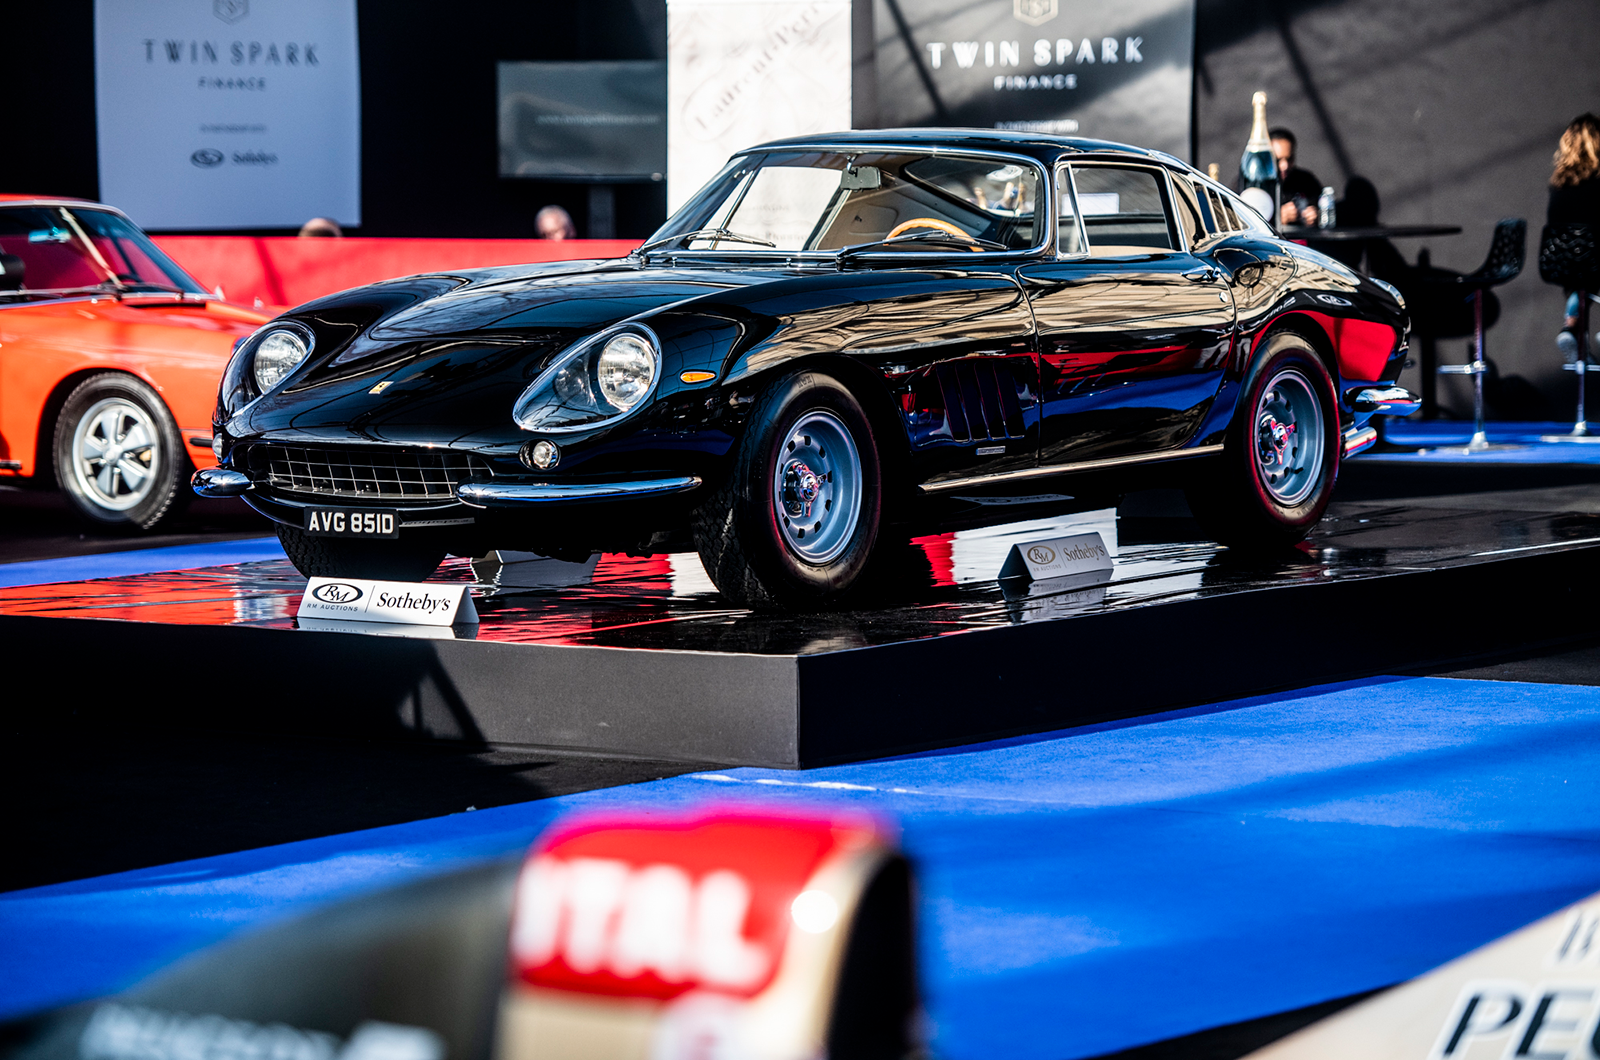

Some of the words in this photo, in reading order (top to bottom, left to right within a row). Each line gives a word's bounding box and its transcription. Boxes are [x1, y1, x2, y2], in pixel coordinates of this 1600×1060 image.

[142, 38, 218, 64] TWIN
[229, 40, 320, 66] SPARK
[926, 40, 1020, 69] TWIN
[1033, 36, 1144, 66] SPARK
[993, 73, 1078, 91] FINANCE
[308, 511, 346, 533] AVG
[350, 512, 395, 534] 851D
[1034, 549, 1049, 562] RM
[1063, 543, 1105, 561] Sotheby's
[322, 585, 350, 602] RM
[376, 591, 451, 615] Sotheby's
[321, 604, 358, 612] AUCTIONS
[1440, 988, 1600, 1060] PE
